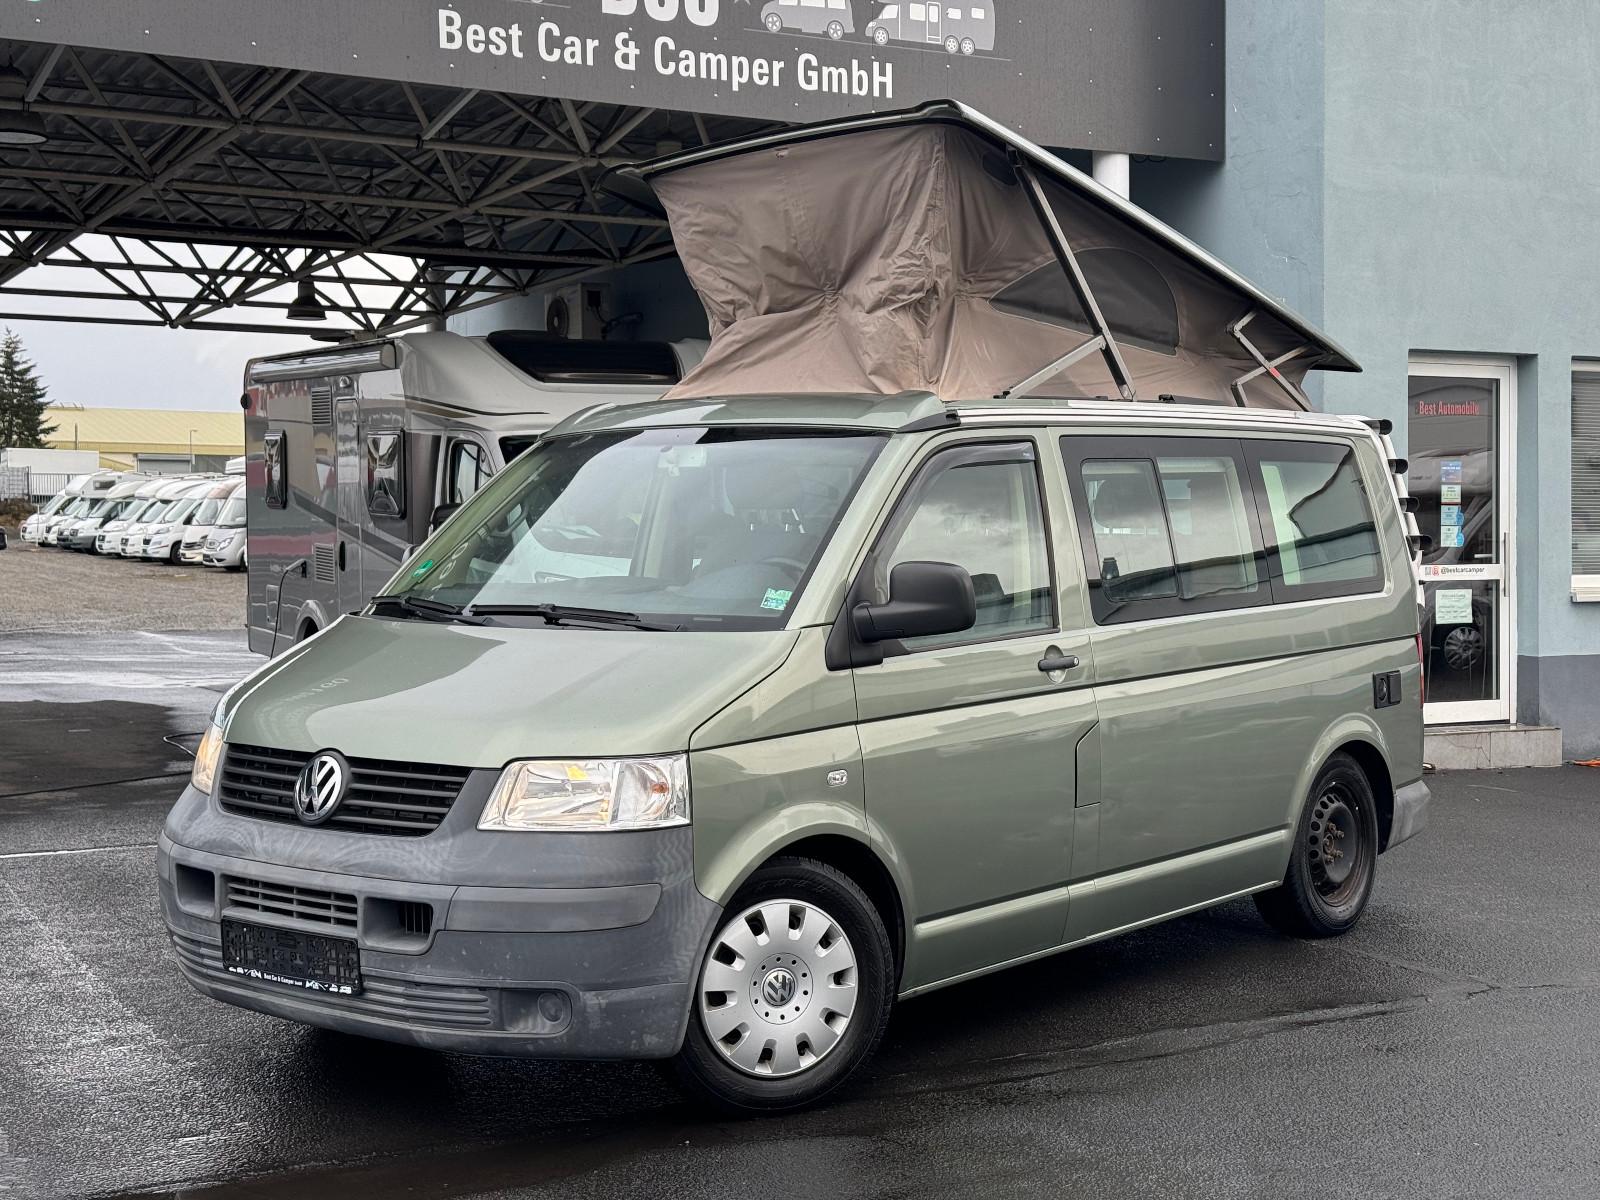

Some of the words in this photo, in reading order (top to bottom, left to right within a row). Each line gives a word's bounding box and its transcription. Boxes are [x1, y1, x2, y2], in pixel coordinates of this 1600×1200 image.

[438, 8, 523, 58] Best
[537, 21, 600, 66] Car
[614, 31, 641, 71] &
[655, 35, 785, 93] Camper
[797, 52, 893, 99] GmbH
[1419, 400, 1436, 415] Best
[1438, 400, 1480, 415] Automobile
